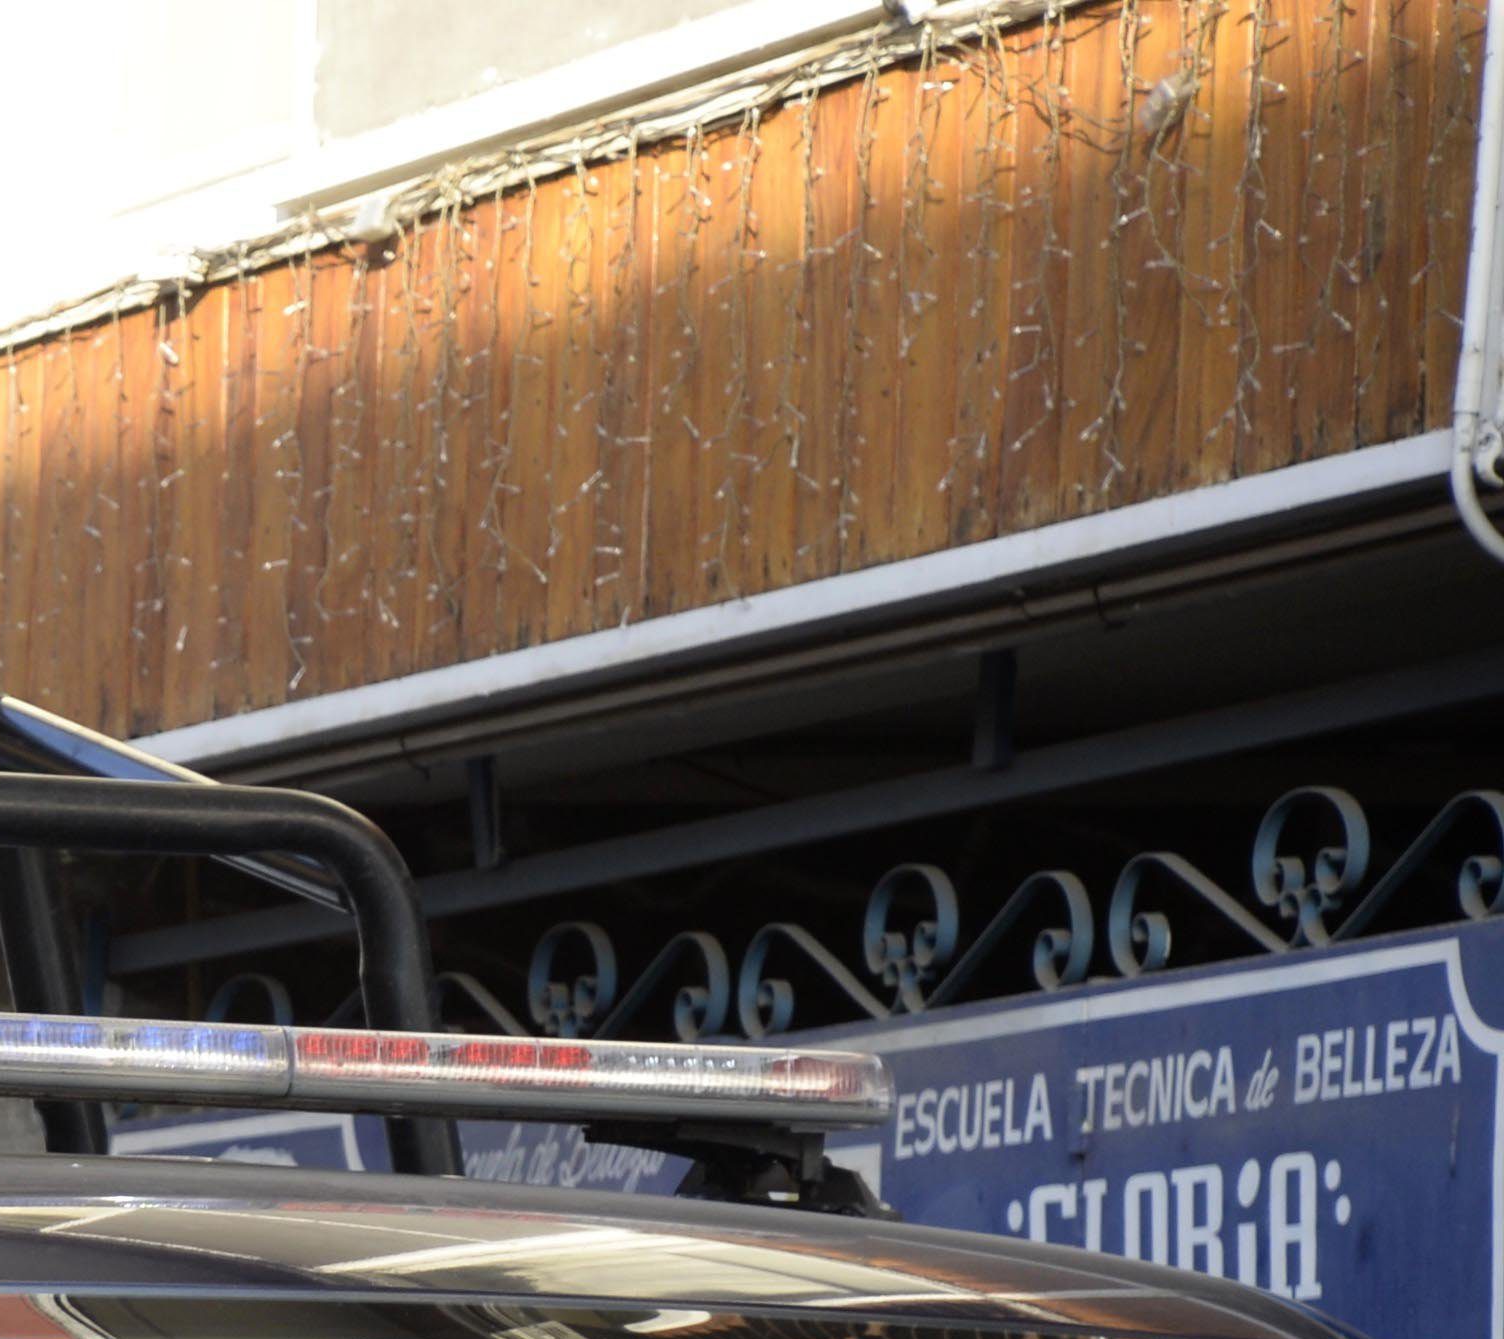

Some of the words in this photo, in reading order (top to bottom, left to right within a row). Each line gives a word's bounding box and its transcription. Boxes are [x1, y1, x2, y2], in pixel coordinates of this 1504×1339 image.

[895, 1073, 1053, 1159] ESCUELA
[1076, 1046, 1236, 1134] TECNICA
[1244, 1047, 1280, 1111] de
[1294, 1013, 1463, 1105] BELLEZA
